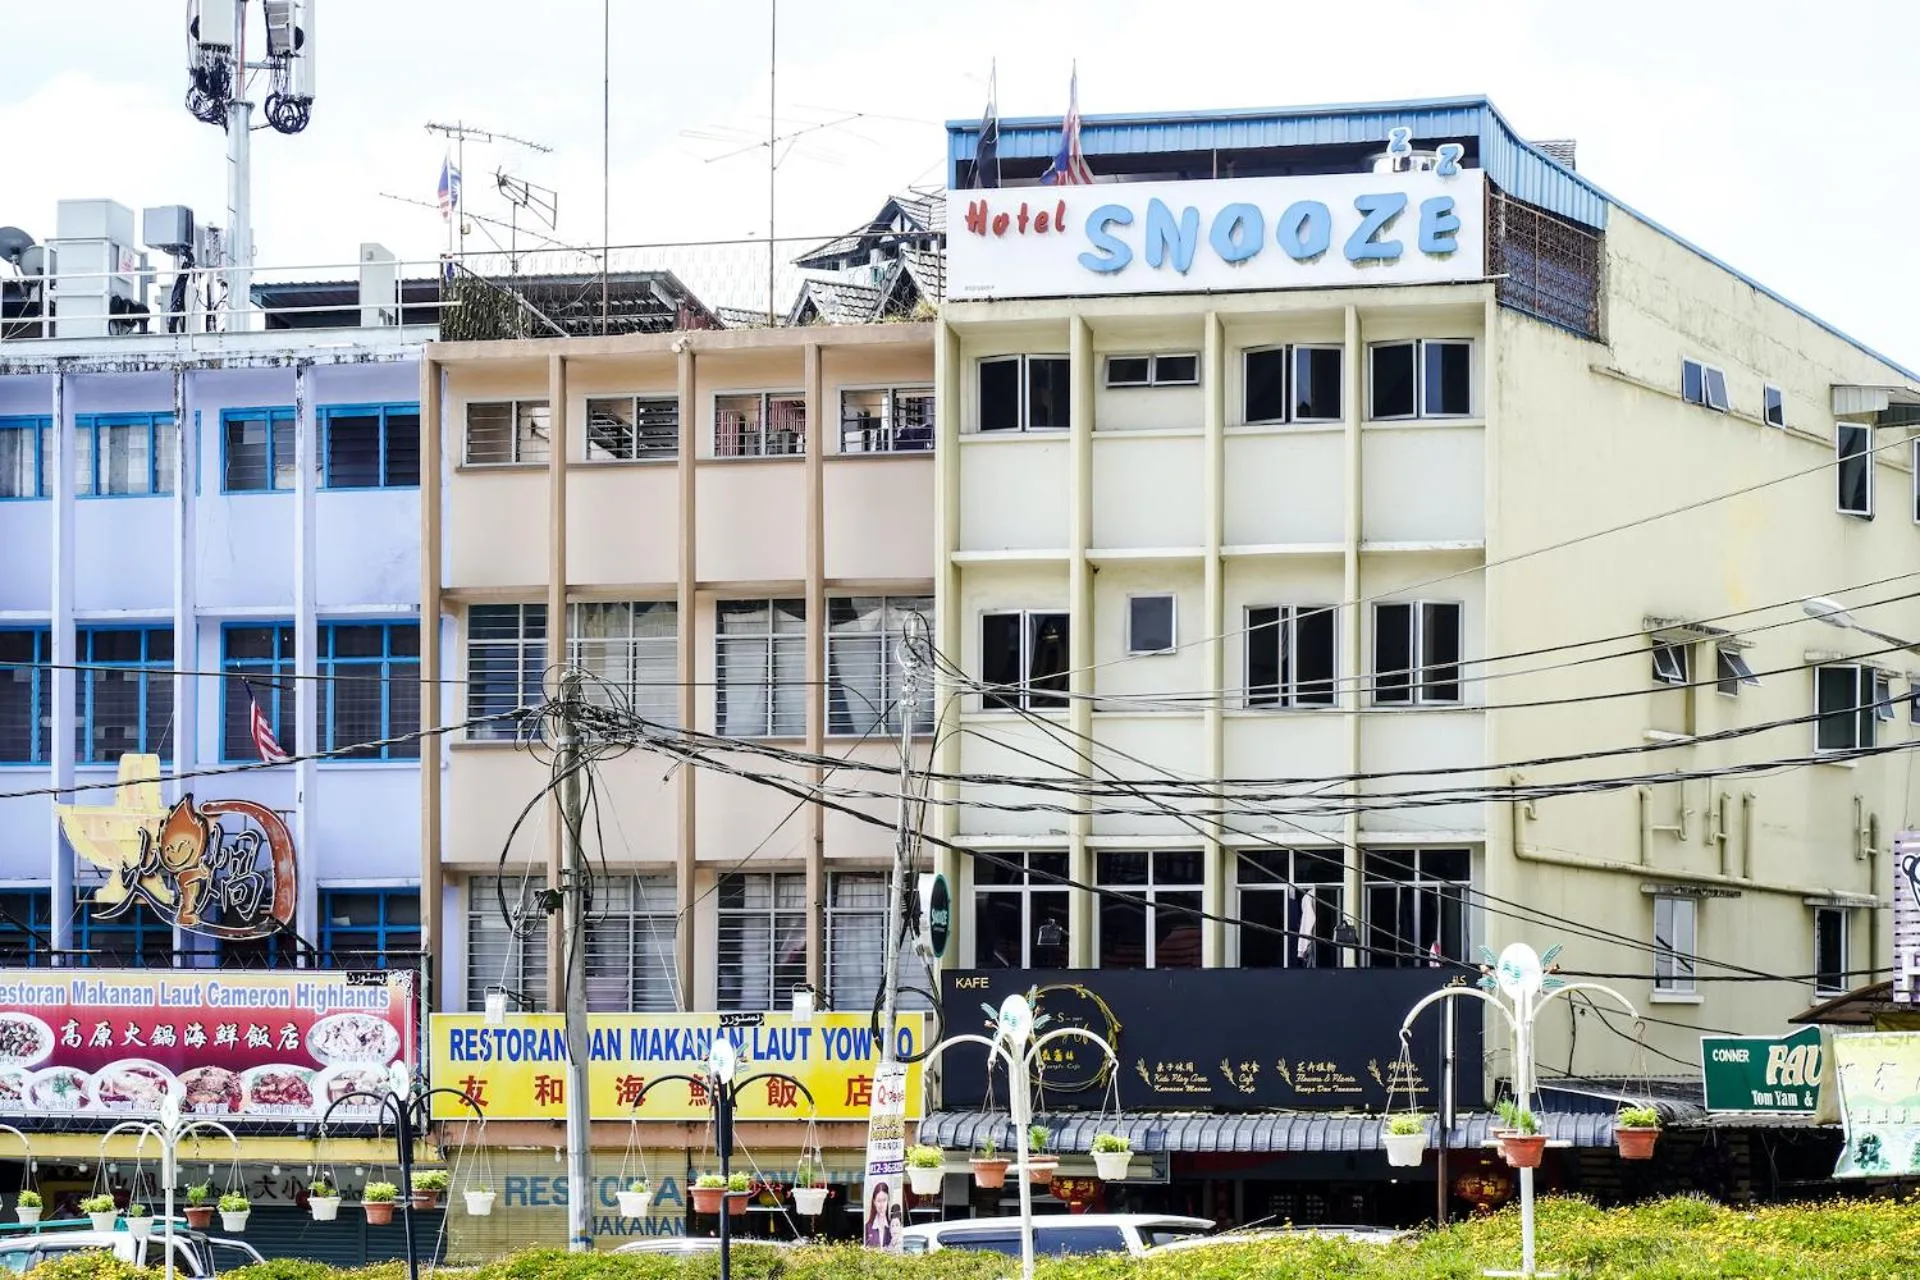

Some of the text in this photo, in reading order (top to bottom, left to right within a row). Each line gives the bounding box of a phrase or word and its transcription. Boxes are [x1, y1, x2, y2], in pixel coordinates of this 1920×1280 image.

[964, 192, 1466, 276] Hotel SNOOZE
[955, 977, 989, 989] KAFE
[72, 981, 153, 1005] Makanan
[160, 982, 201, 1005] Laut
[207, 982, 289, 1007] Cameron
[296, 983, 390, 1013] Highlands
[60, 1019, 300, 1051] 高原火鍋海鮮飯店
[450, 1028, 567, 1062] RESTORAN
[587, 1028, 622, 1061] AN
[753, 1027, 812, 1061] LAUT
[821, 1027, 872, 1061] YOW
[1712, 1048, 1750, 1063] CONNER
[1751, 1090, 1813, 1107] Tom Yam &
[591, 1216, 687, 1236] AKANAN
